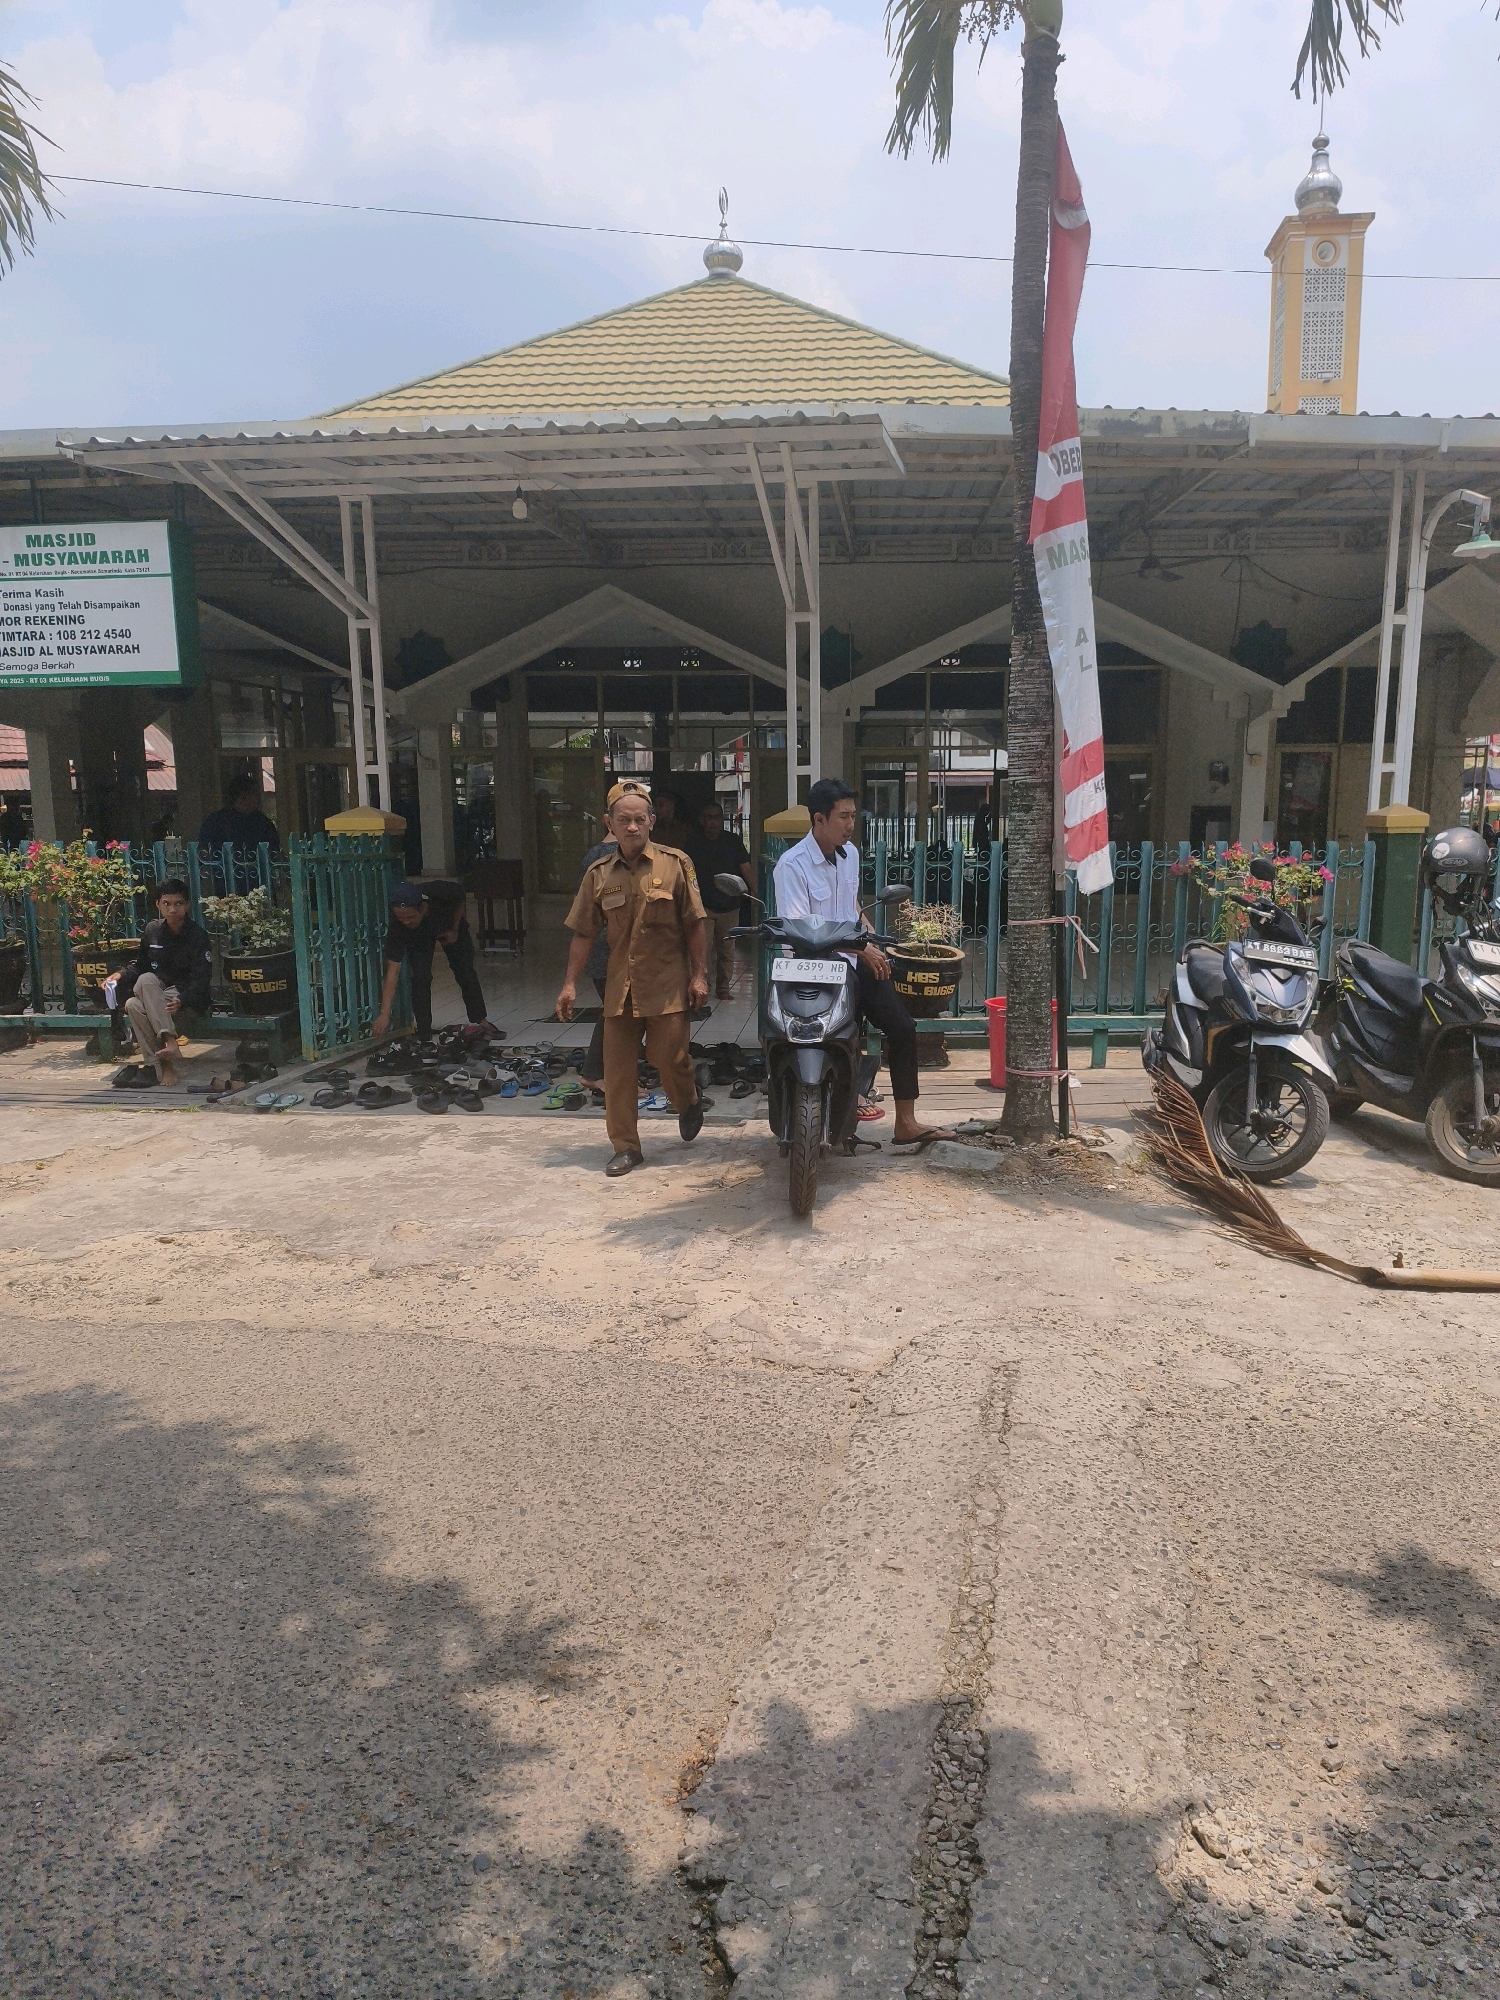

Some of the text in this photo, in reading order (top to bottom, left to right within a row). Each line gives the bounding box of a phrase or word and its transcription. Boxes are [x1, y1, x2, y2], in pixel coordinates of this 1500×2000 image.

[25, 532, 96, 548] MASJID
[13, 549, 150, 567] MUSYAWARAH
[34, 588, 65, 598] Kasih
[3, 599, 141, 613] Donasi yang Telah Disampaikan
[25, 614, 86, 626] REKENING
[56, 629, 77, 640] 108
[80, 629, 101, 640] 212
[103, 628, 132, 640] 4540
[38, 645, 54, 657] AL
[56, 643, 141, 656] MUSYAWARAH
[0, 660, 75, 672] Semoga Berkah
[49, 675, 88, 683] KELURAHAN
[1247, 941, 1261, 950] KT
[1472, 942, 1485, 953] KT
[76, 963, 108, 975] HBS
[775, 960, 845, 973] KT 6399 NB
[231, 968, 264, 980] HBS
[906, 970, 940, 984] HBS
